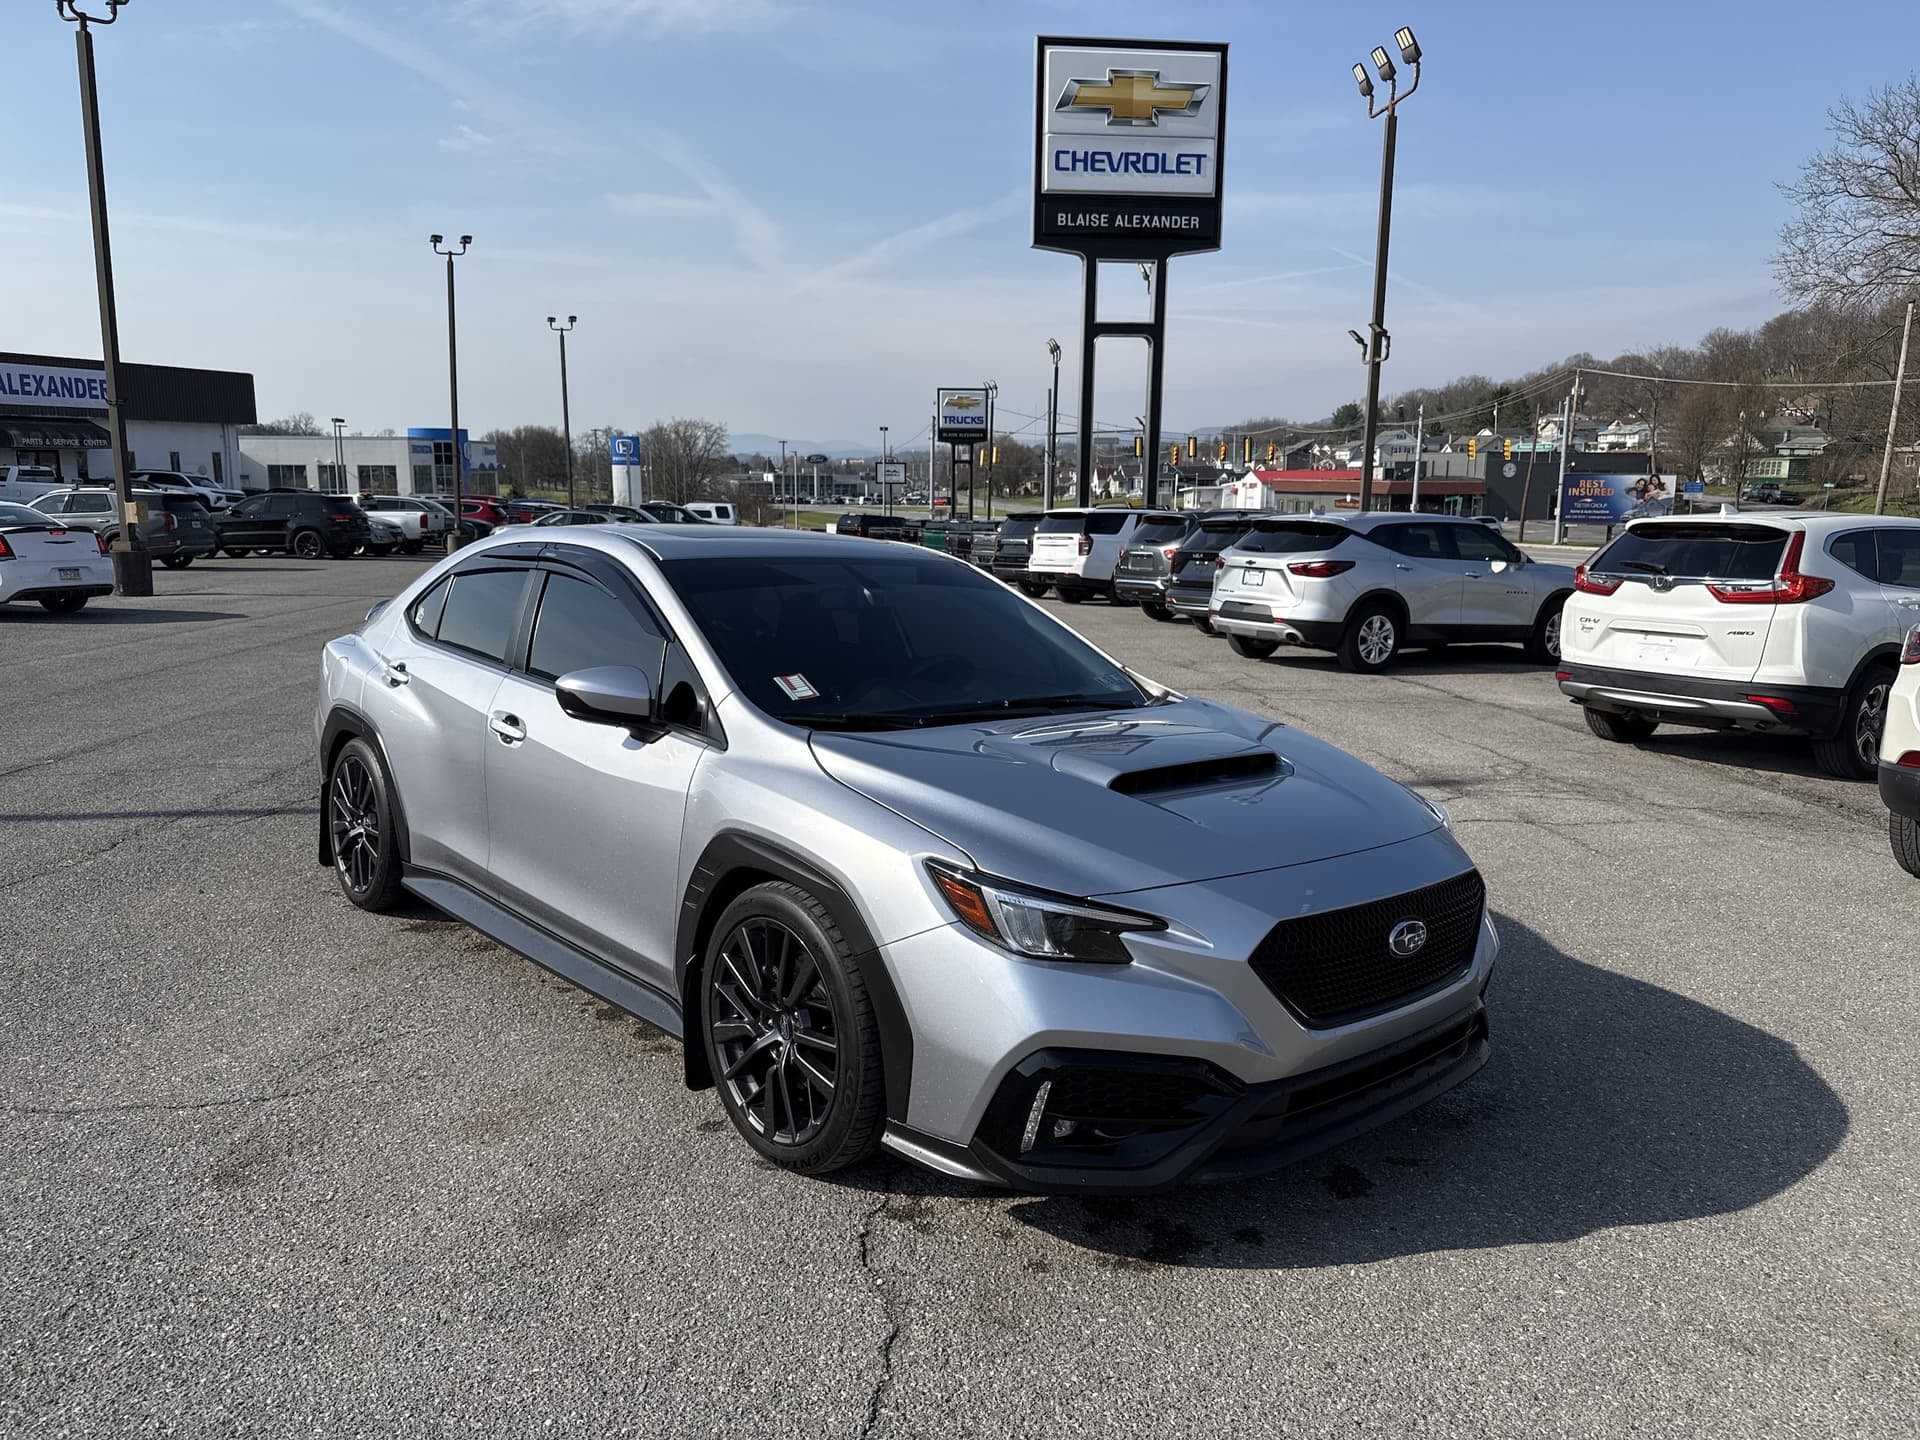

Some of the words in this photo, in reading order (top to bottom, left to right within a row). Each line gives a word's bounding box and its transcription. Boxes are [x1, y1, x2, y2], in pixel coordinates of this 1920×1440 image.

[1055, 150, 1207, 175] CHEVROLET
[1057, 213, 1109, 227] BLAISE
[1114, 214, 1200, 229] ALEXANDER
[943, 416, 984, 424] TRUCKS
[22, 438, 43, 446] PARTS
[1579, 480, 1606, 488] REST
[1568, 488, 1616, 496] INSURED
[1579, 616, 1601, 624] CR-V
